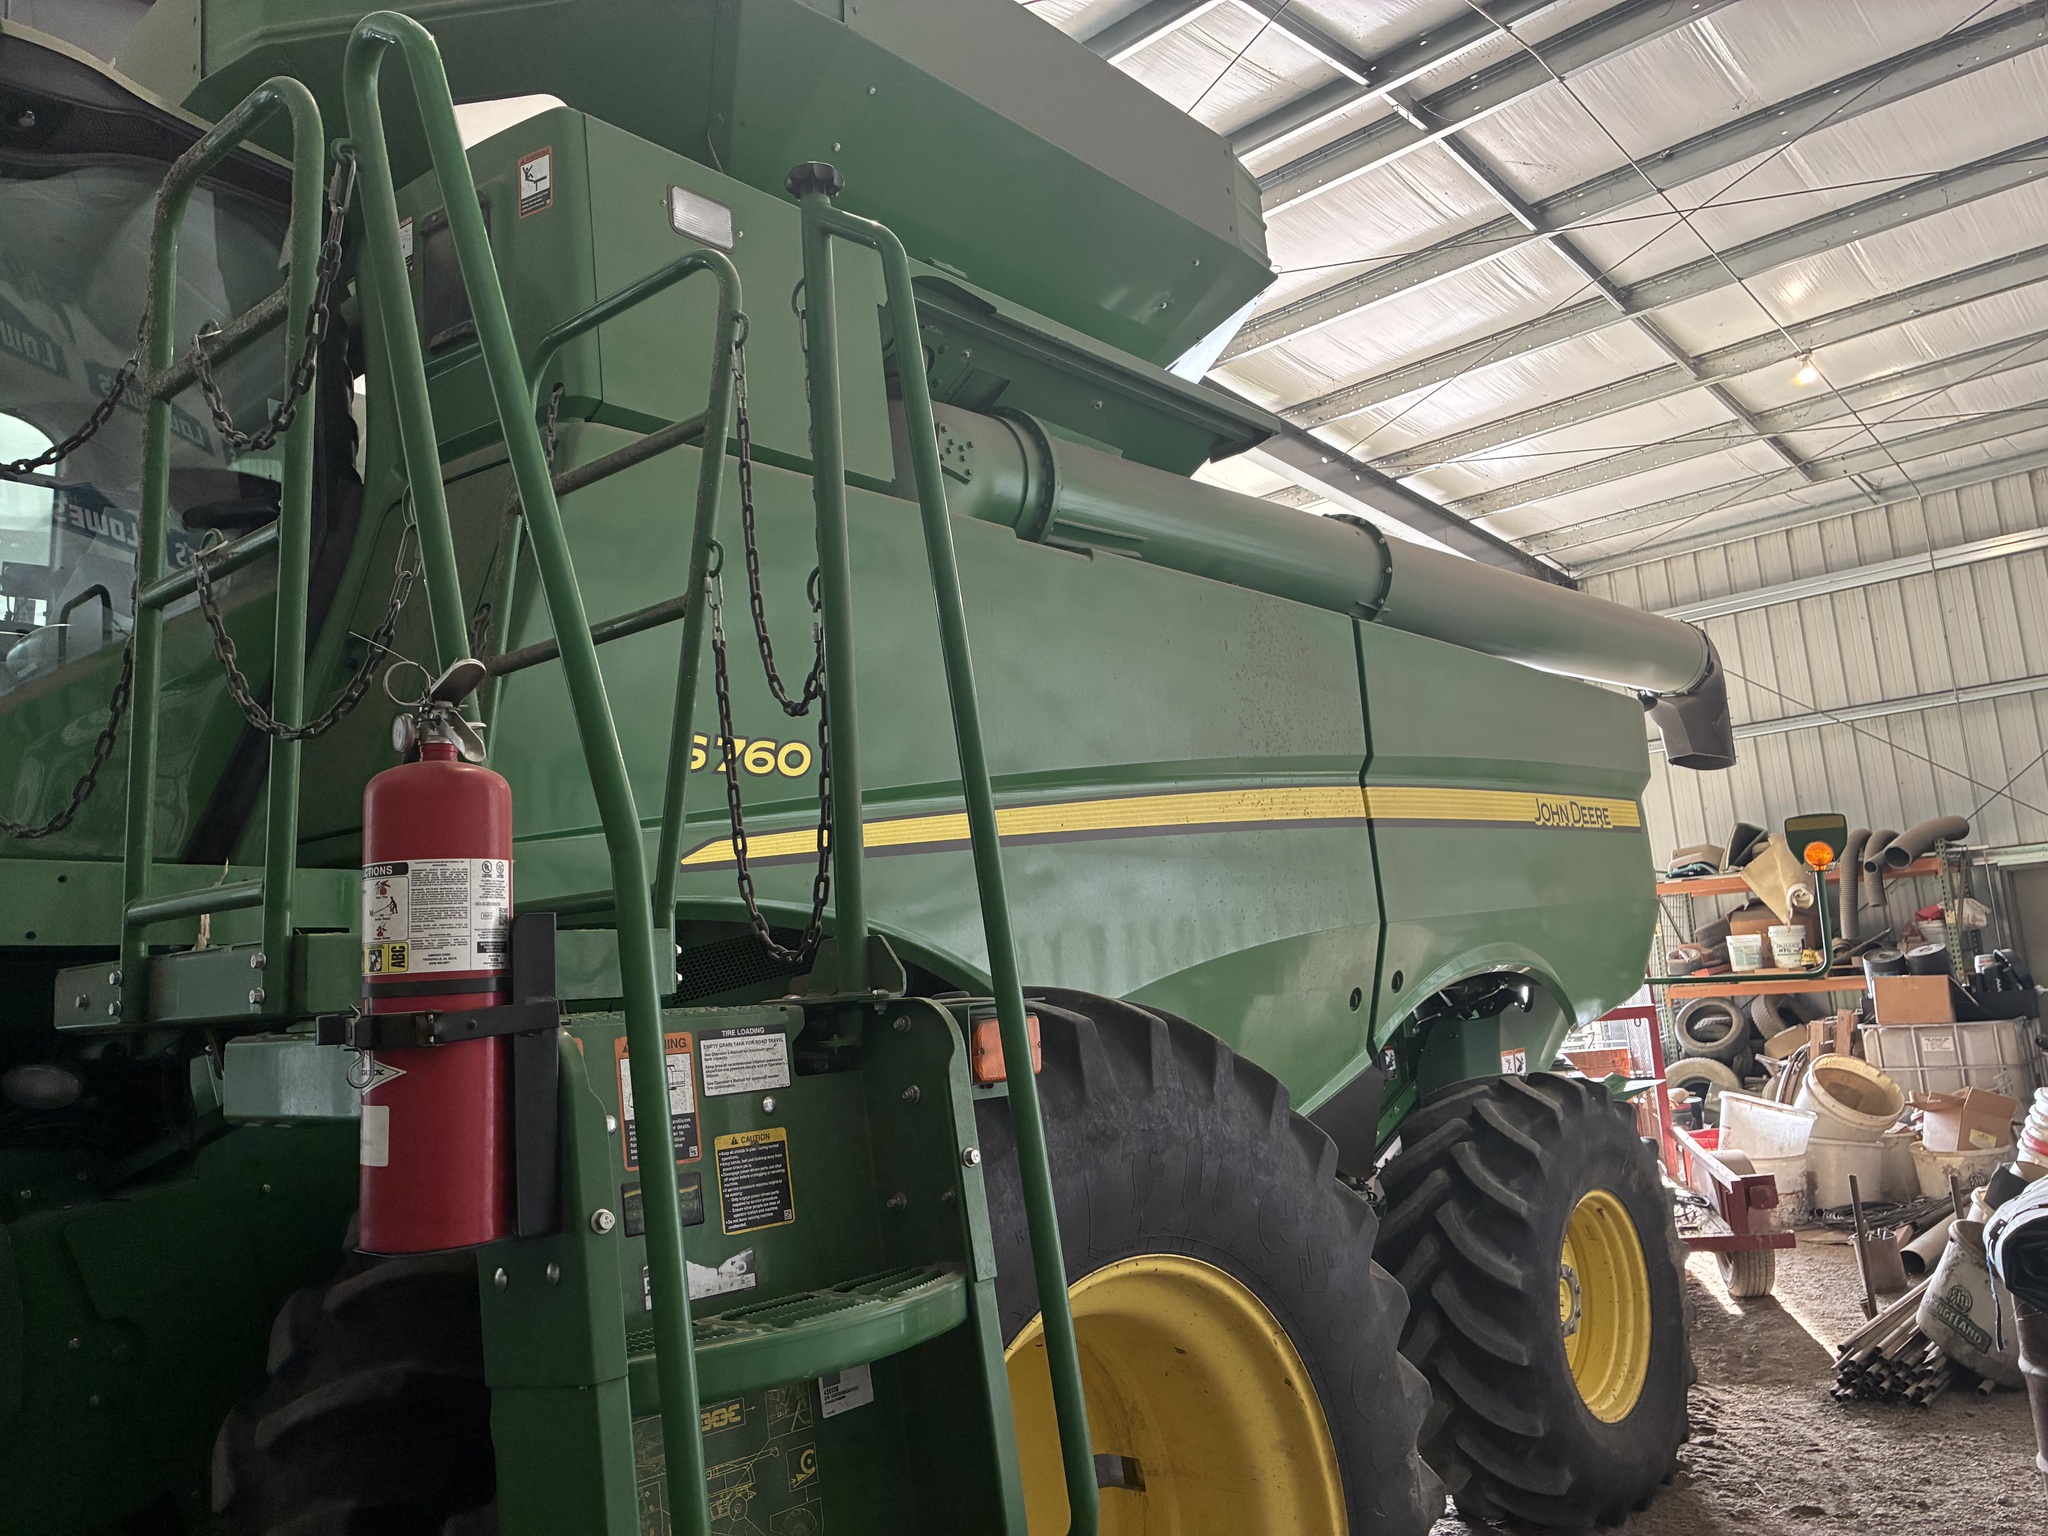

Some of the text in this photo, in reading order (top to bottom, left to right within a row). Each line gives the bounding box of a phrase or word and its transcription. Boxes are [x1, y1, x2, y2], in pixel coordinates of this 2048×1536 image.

[1535, 798, 1611, 826] JOHN DEERE
[391, 946, 405, 968] ABC
[737, 1027, 764, 1035] LOADING
[741, 1133, 770, 1143] CAUTION
